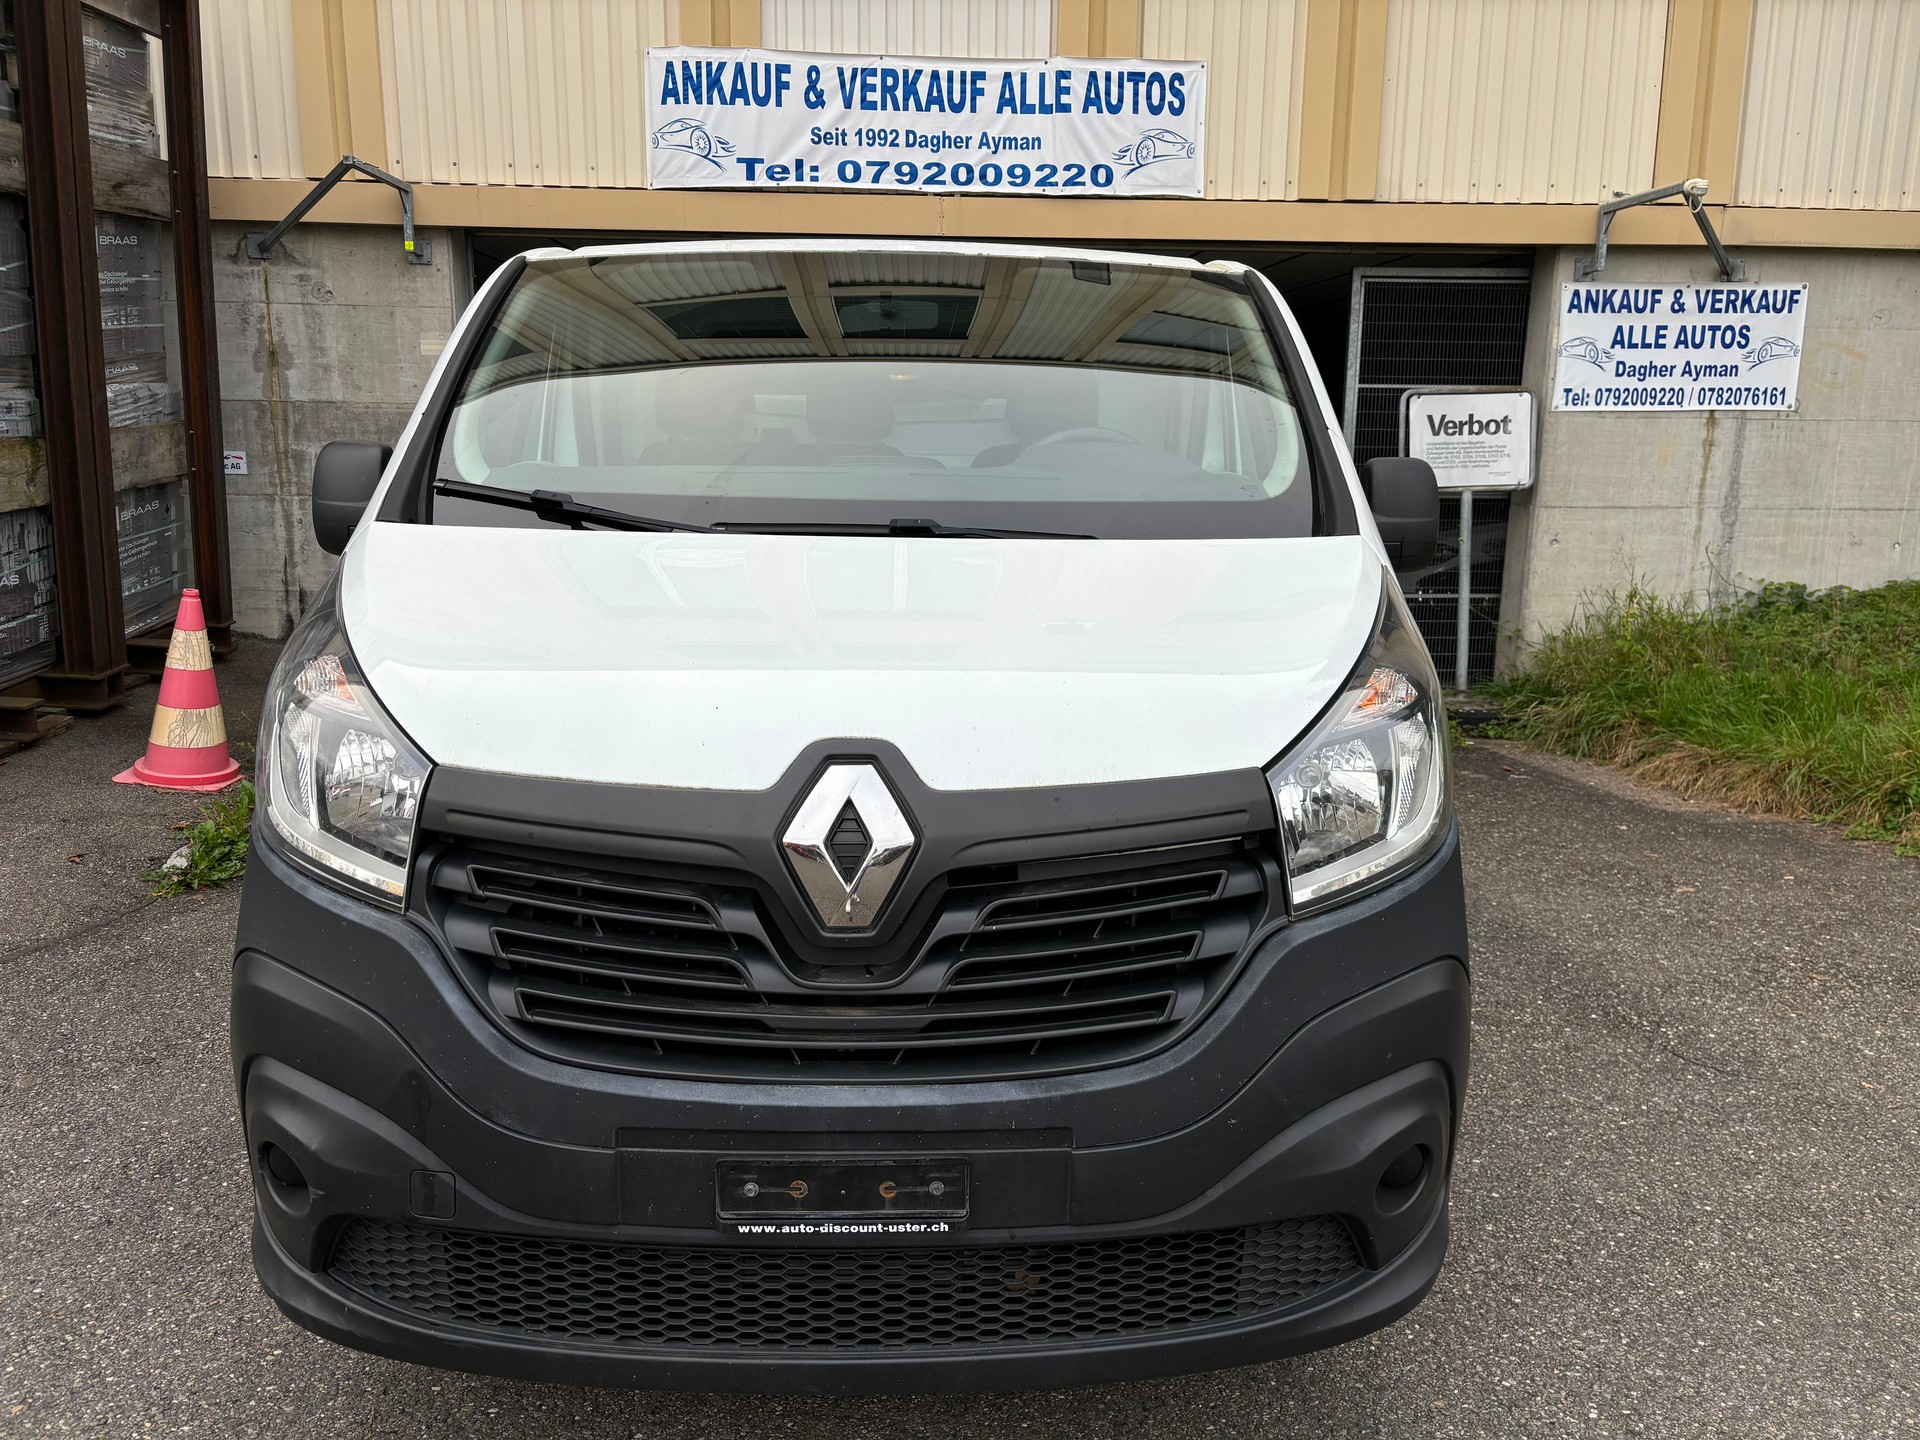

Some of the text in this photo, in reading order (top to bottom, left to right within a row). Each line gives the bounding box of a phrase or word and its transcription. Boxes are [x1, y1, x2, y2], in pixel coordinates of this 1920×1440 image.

[83, 36, 126, 58] BRAAS
[661, 61, 1185, 116] ANKAUF & VERKAUF ALLE AUTOS
[811, 127, 1042, 154] Seit 1992 Dagher Ayman
[736, 157, 1115, 187] Tel: 0792009220
[100, 236, 137, 245] BRAAS
[1567, 289, 1801, 314] ANKAUF & VERKAUF
[1610, 325, 1750, 349] ALLE AUTOS
[1615, 361, 1738, 382] Dagher Ayman
[1563, 388, 1589, 406] Tel:
[1595, 388, 1684, 405] 0792009220
[1698, 387, 1786, 405] 0782076161
[1426, 413, 1512, 436] Verbot
[121, 501, 159, 521] BRAAS
[738, 1222, 949, 1233] www.auto-discount-uster.ch
